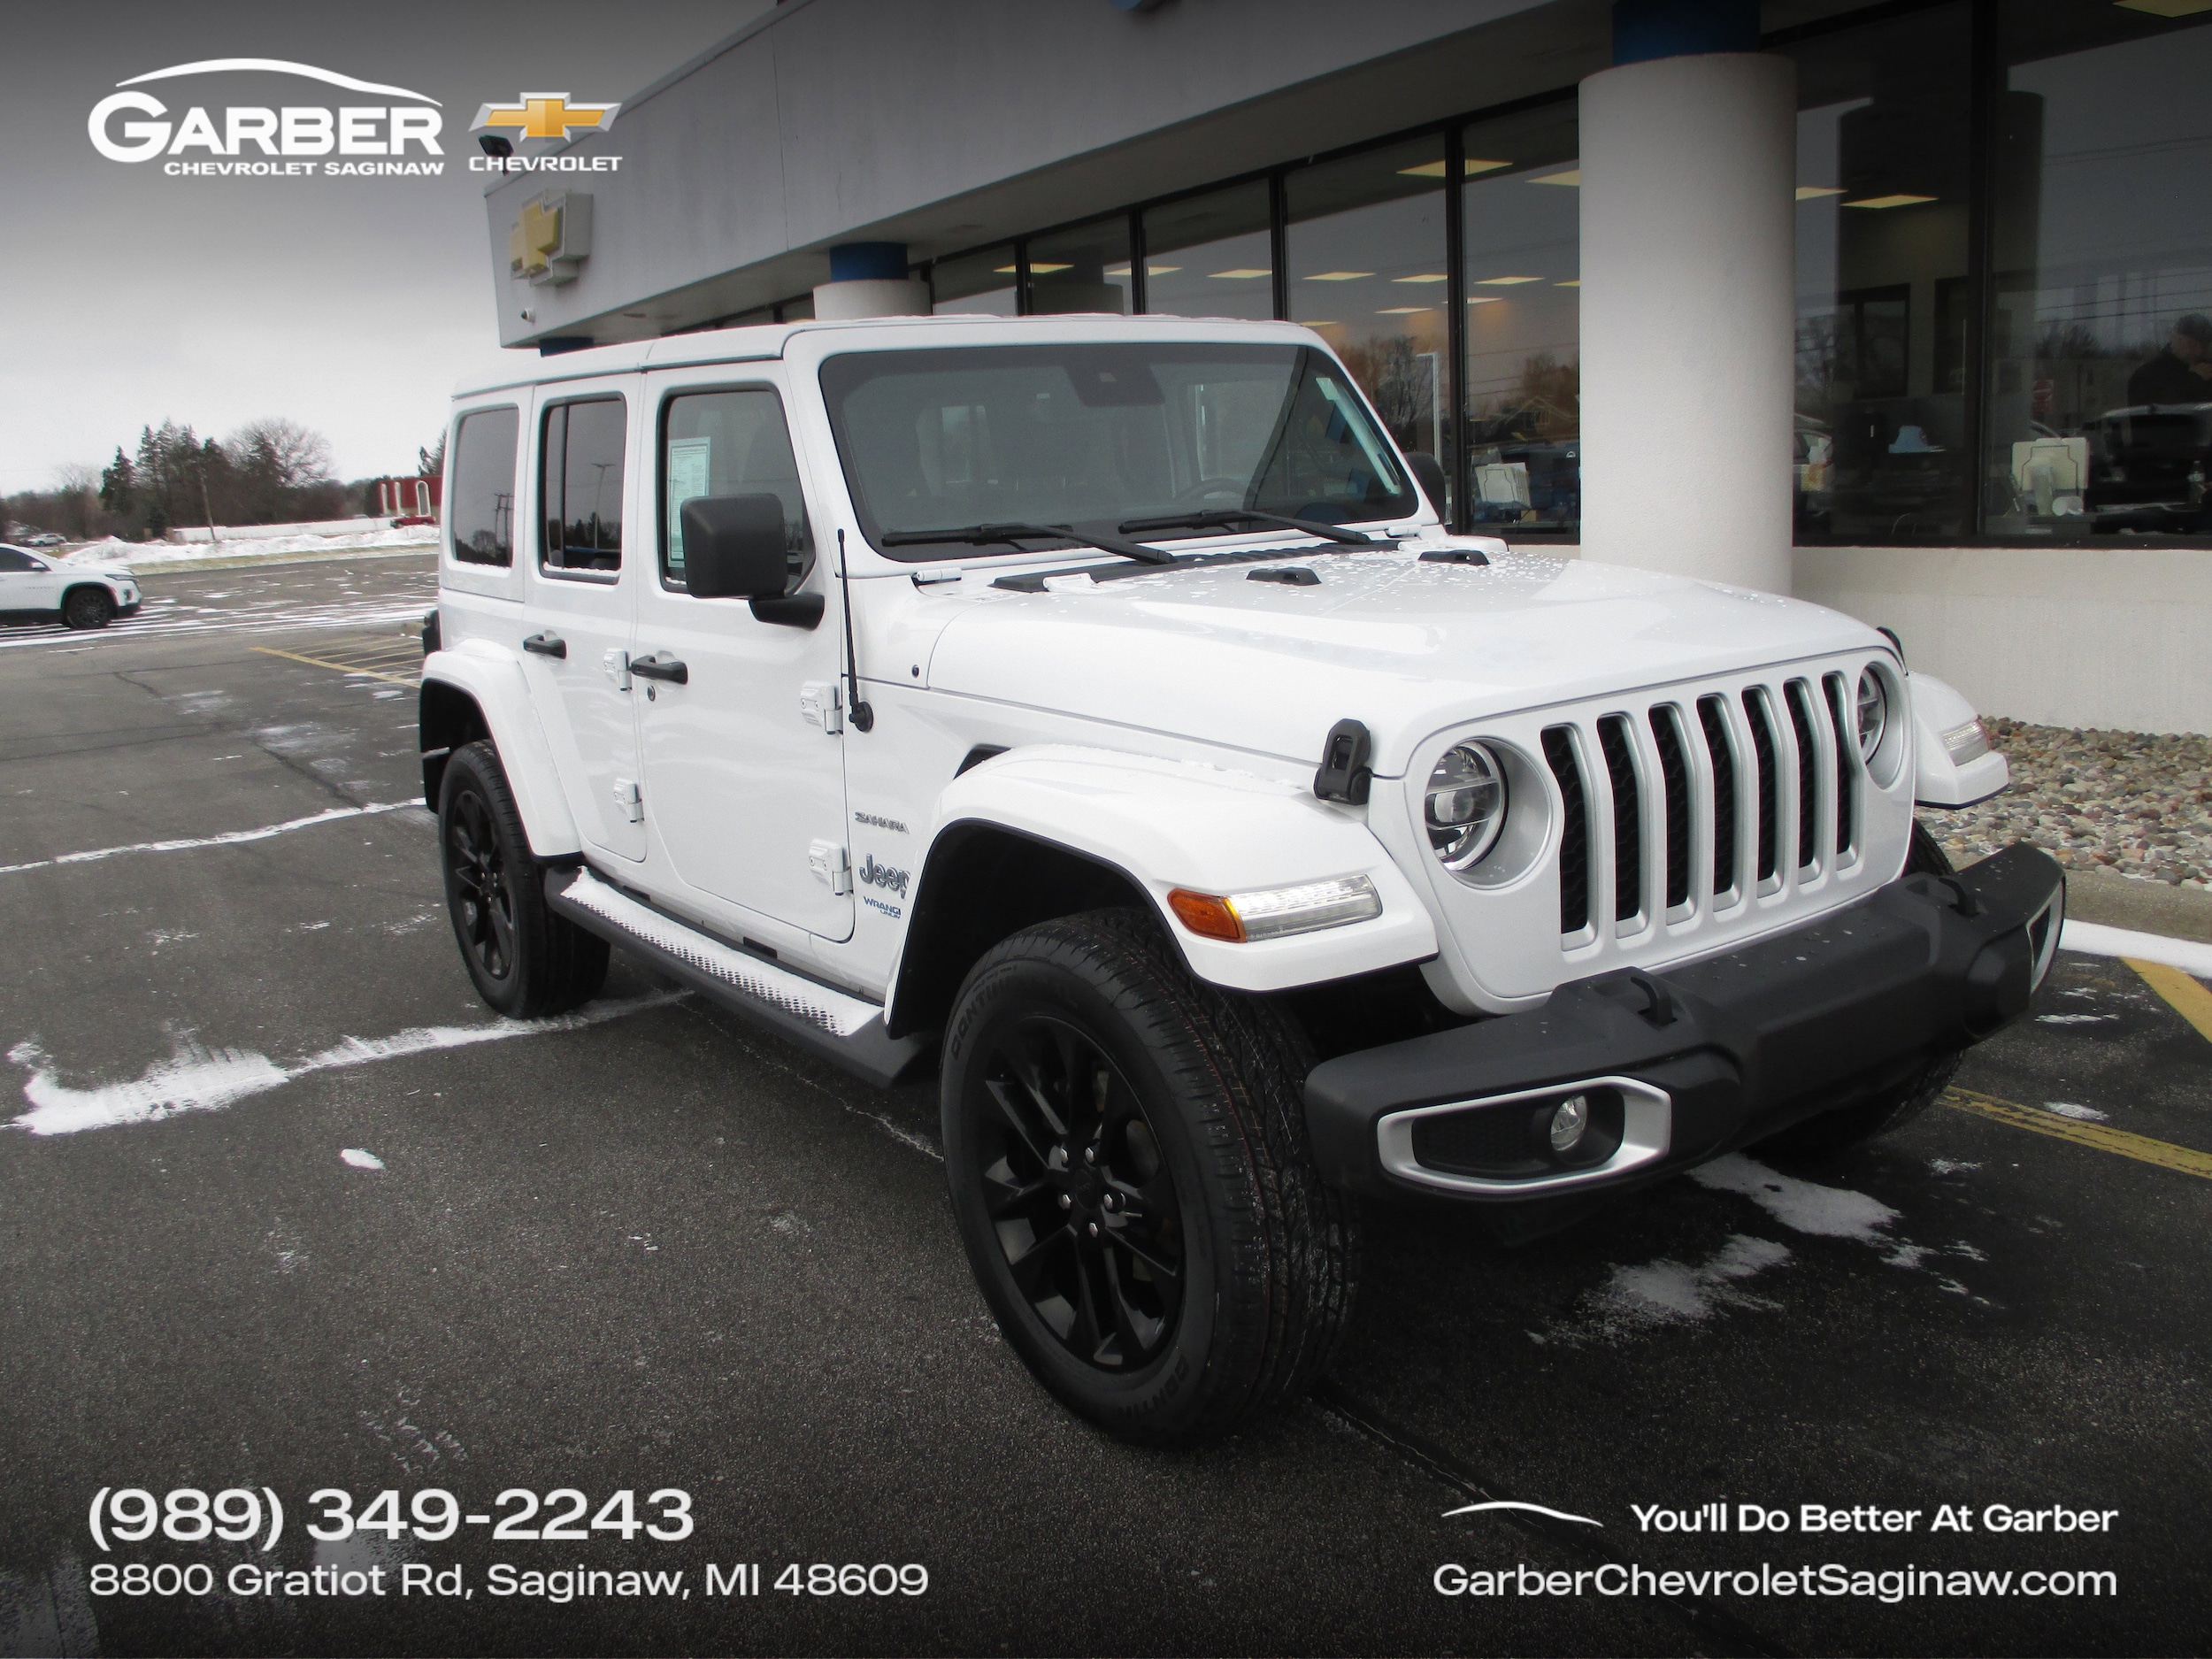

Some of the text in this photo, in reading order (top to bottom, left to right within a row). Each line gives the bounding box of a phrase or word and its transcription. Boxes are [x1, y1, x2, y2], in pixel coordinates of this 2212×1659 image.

[855, 811, 910, 834] SAHARA
[859, 853, 911, 900] Jeep
[863, 895, 902, 916] WRANGL
